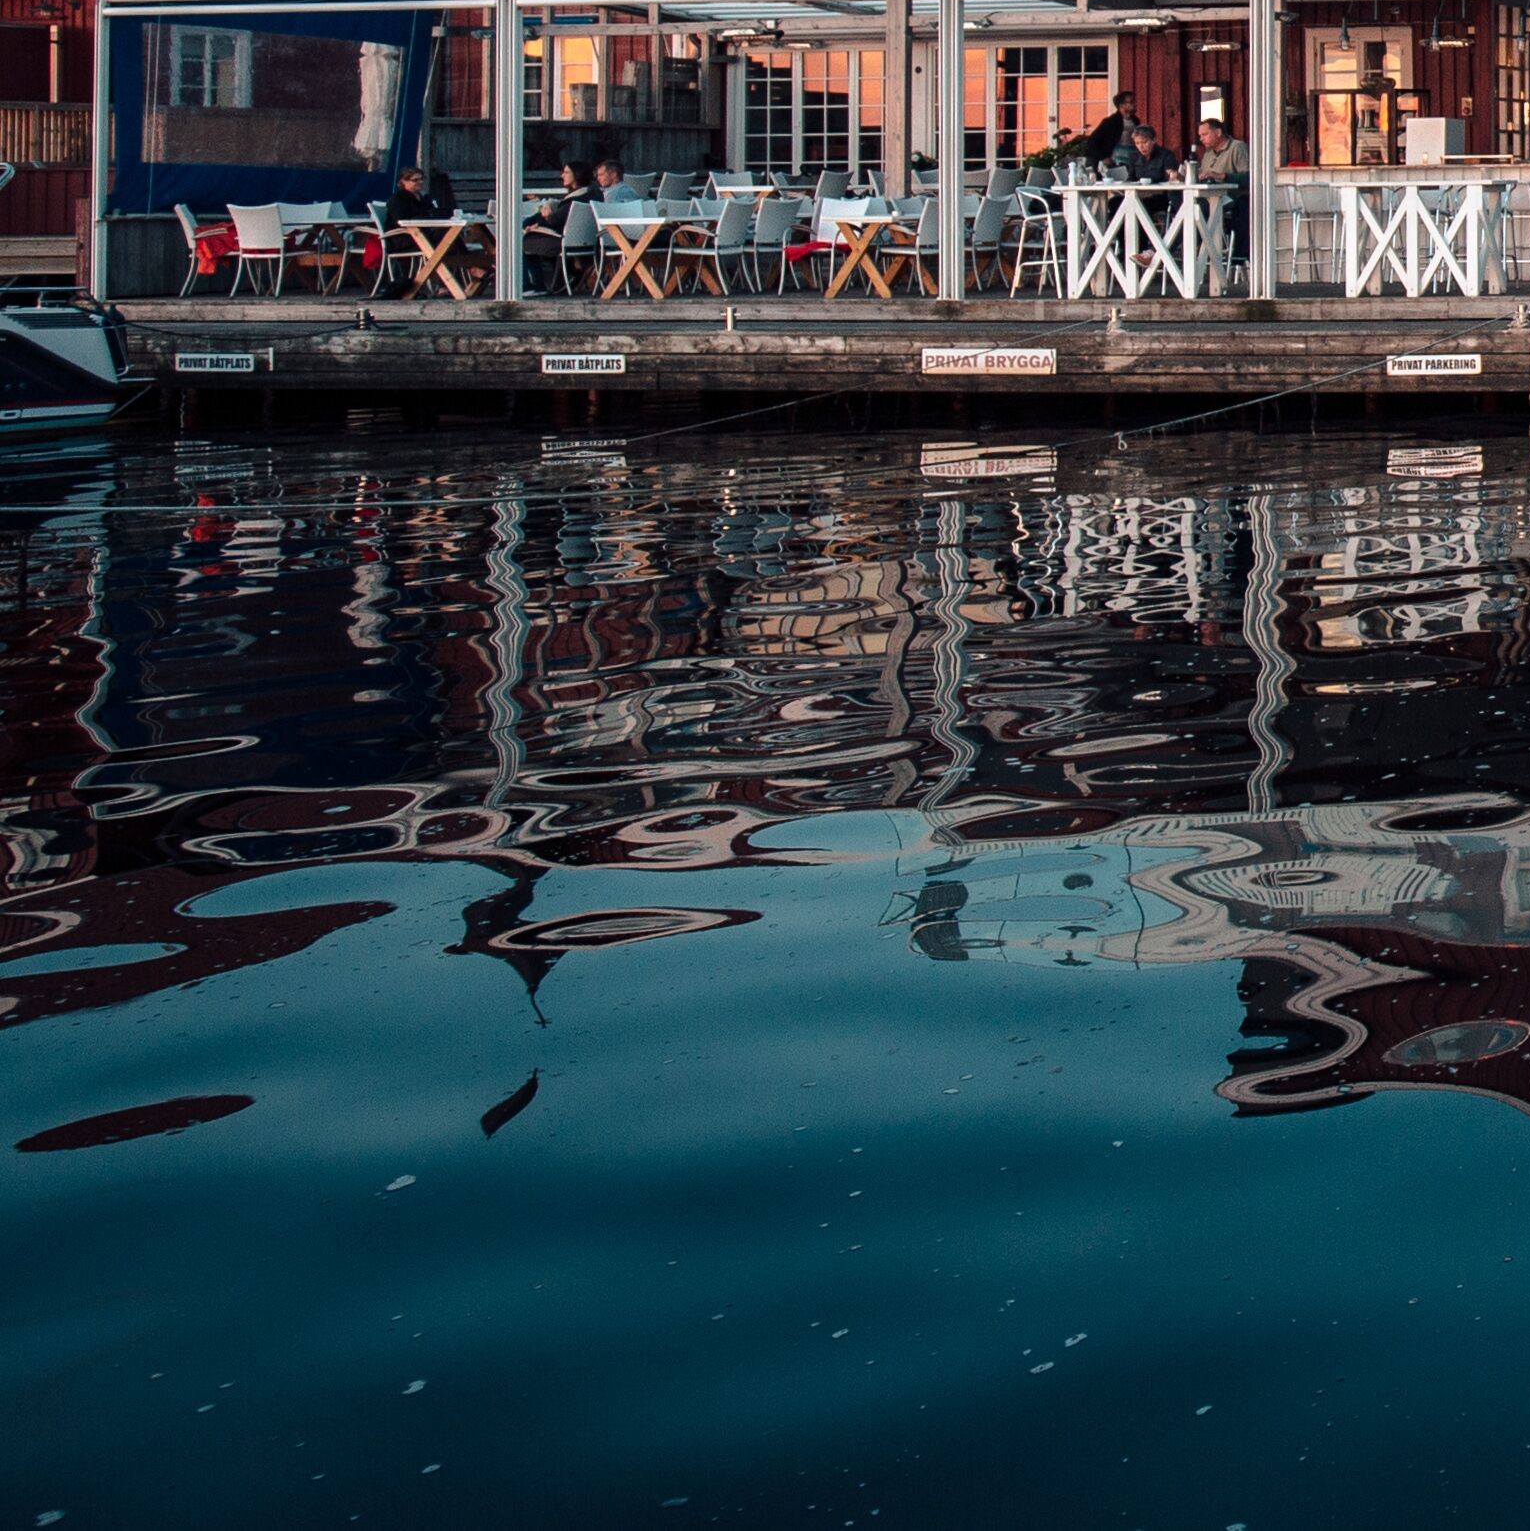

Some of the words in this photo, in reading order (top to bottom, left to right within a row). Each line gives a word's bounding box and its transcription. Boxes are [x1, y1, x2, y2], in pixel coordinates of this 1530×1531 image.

[178, 357, 207, 369] PRIVAT
[208, 355, 252, 369] BÅTPLATS
[545, 358, 577, 371] PRIVAT
[578, 356, 622, 371] BÅTPLATS
[924, 354, 979, 369] PRIVAT
[984, 354, 1052, 369] BRYGGA
[1391, 359, 1423, 371] PRIVAT
[1425, 358, 1477, 371] PARKERING
